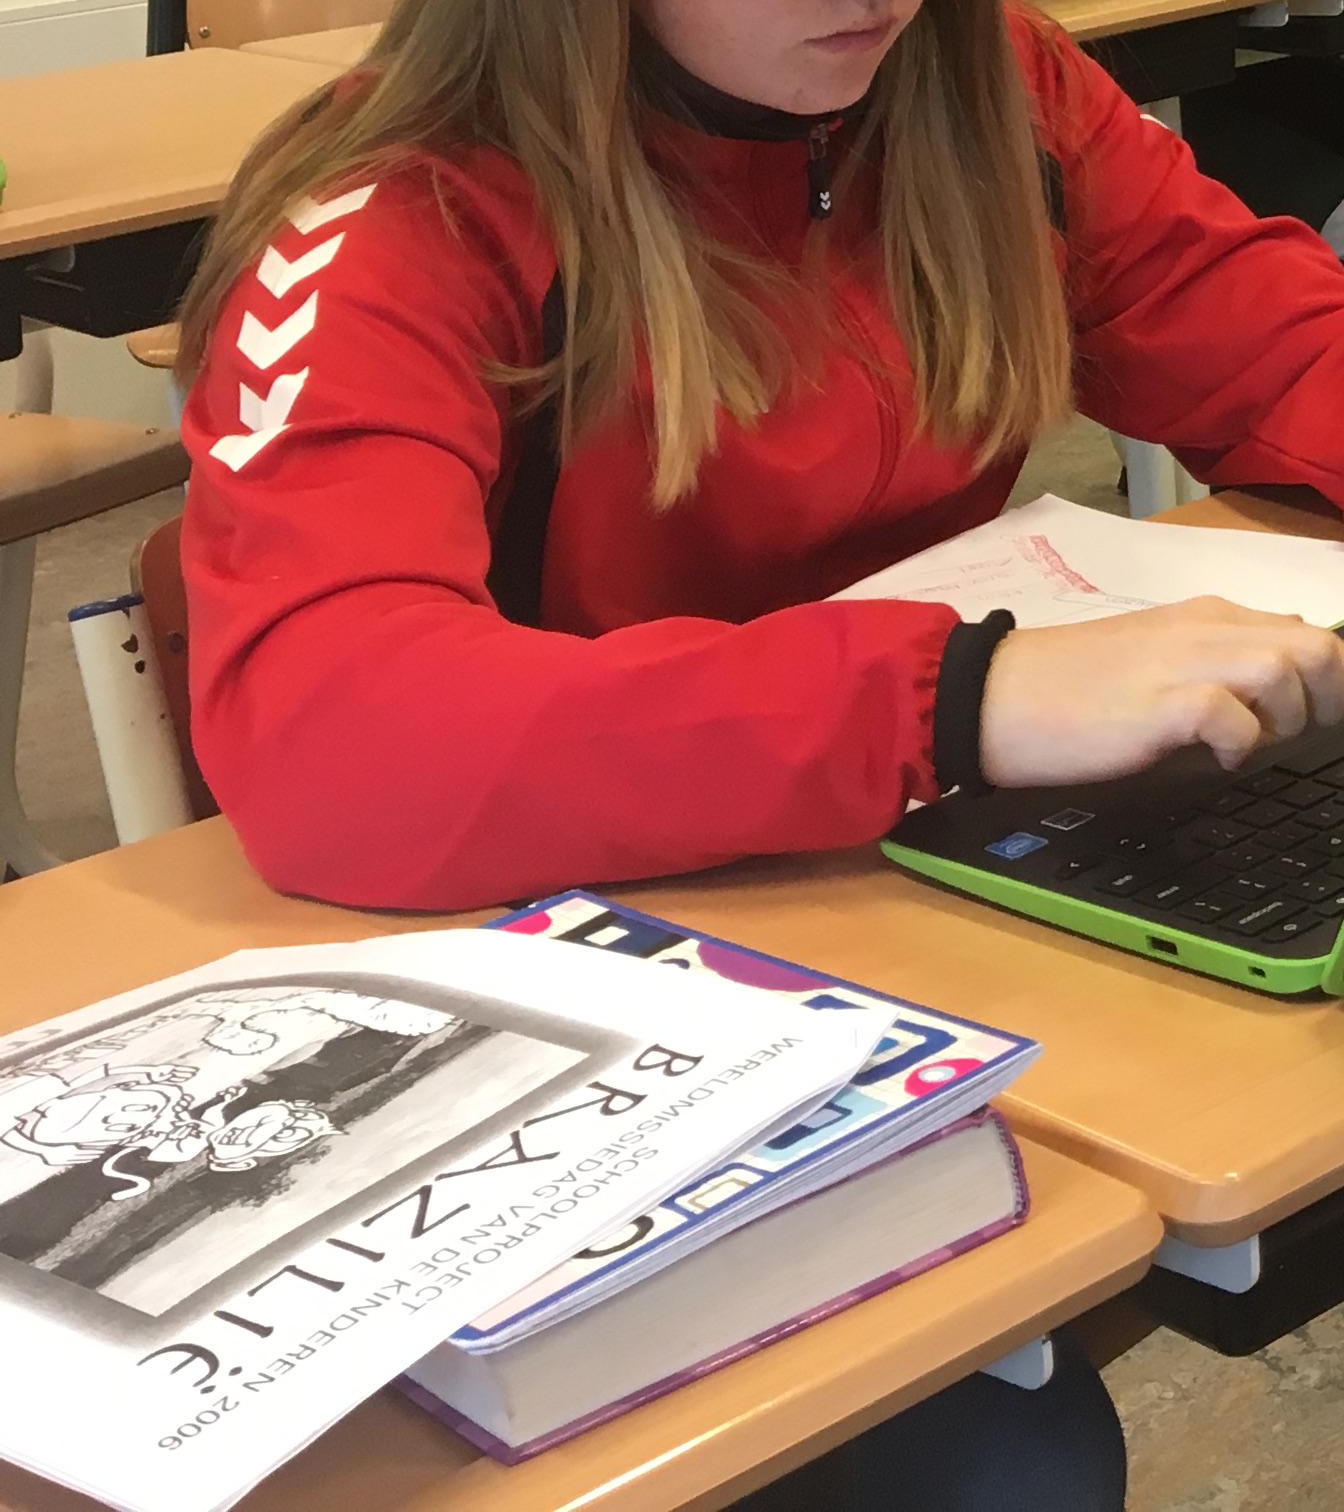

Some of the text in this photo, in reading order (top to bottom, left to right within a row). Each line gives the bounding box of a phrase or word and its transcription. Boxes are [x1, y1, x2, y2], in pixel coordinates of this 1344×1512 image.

[136, 1041, 705, 1396] BRAZILIË
[157, 1036, 804, 1453] WERELDMISSIEDAG VAN DE KINDEREN 2006
[408, 1144, 660, 1316] SCHOOLPROJECT
